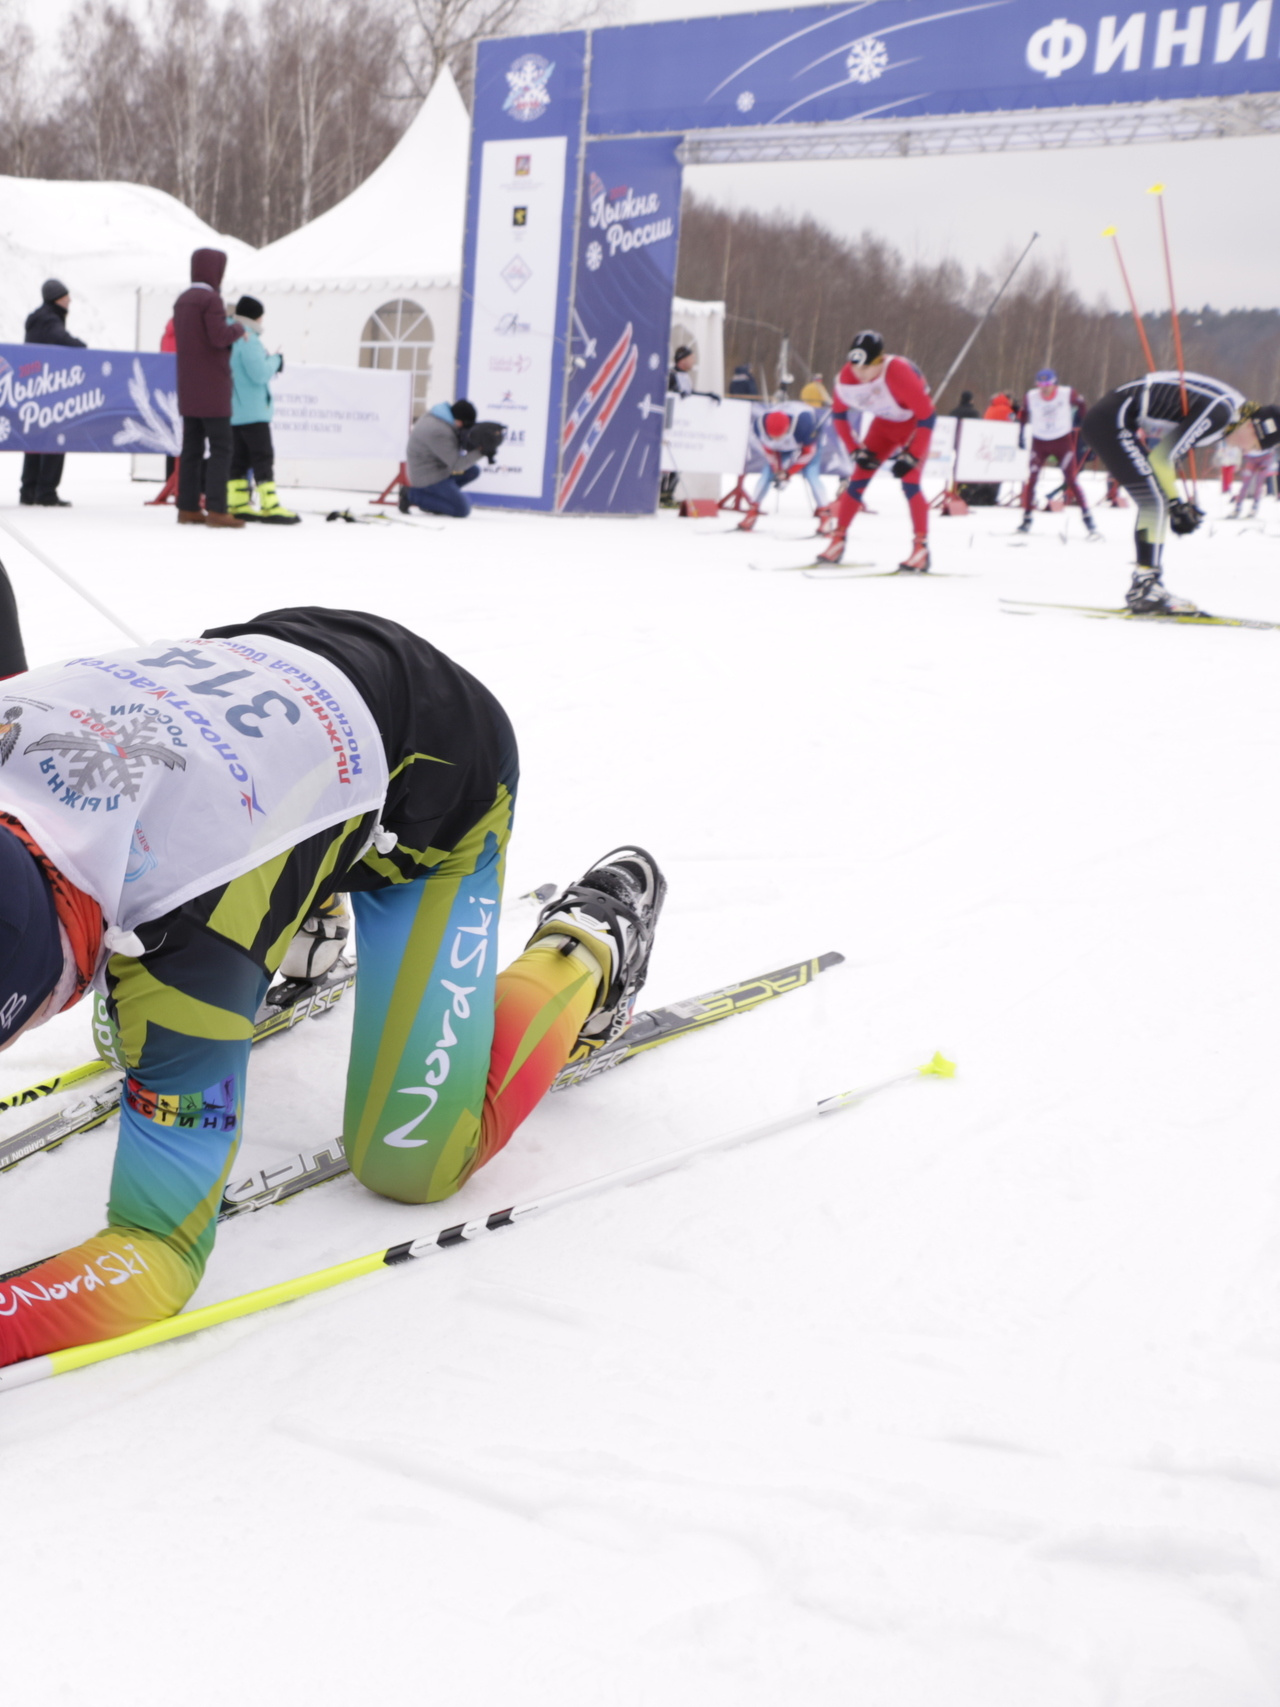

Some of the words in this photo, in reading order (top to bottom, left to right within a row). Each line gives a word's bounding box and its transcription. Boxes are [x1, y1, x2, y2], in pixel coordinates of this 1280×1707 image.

[588, 186, 660, 230] Лыжня
[606, 217, 674, 257] России
[19, 388, 106, 434] России
[136, 647, 301, 738] 314
[70, 708, 118, 740] 2019
[111, 703, 188, 748] РОССИИ
[39, 757, 120, 812] ЛЫЖНЯ
[12, 1138, 46, 1162] CARBON
